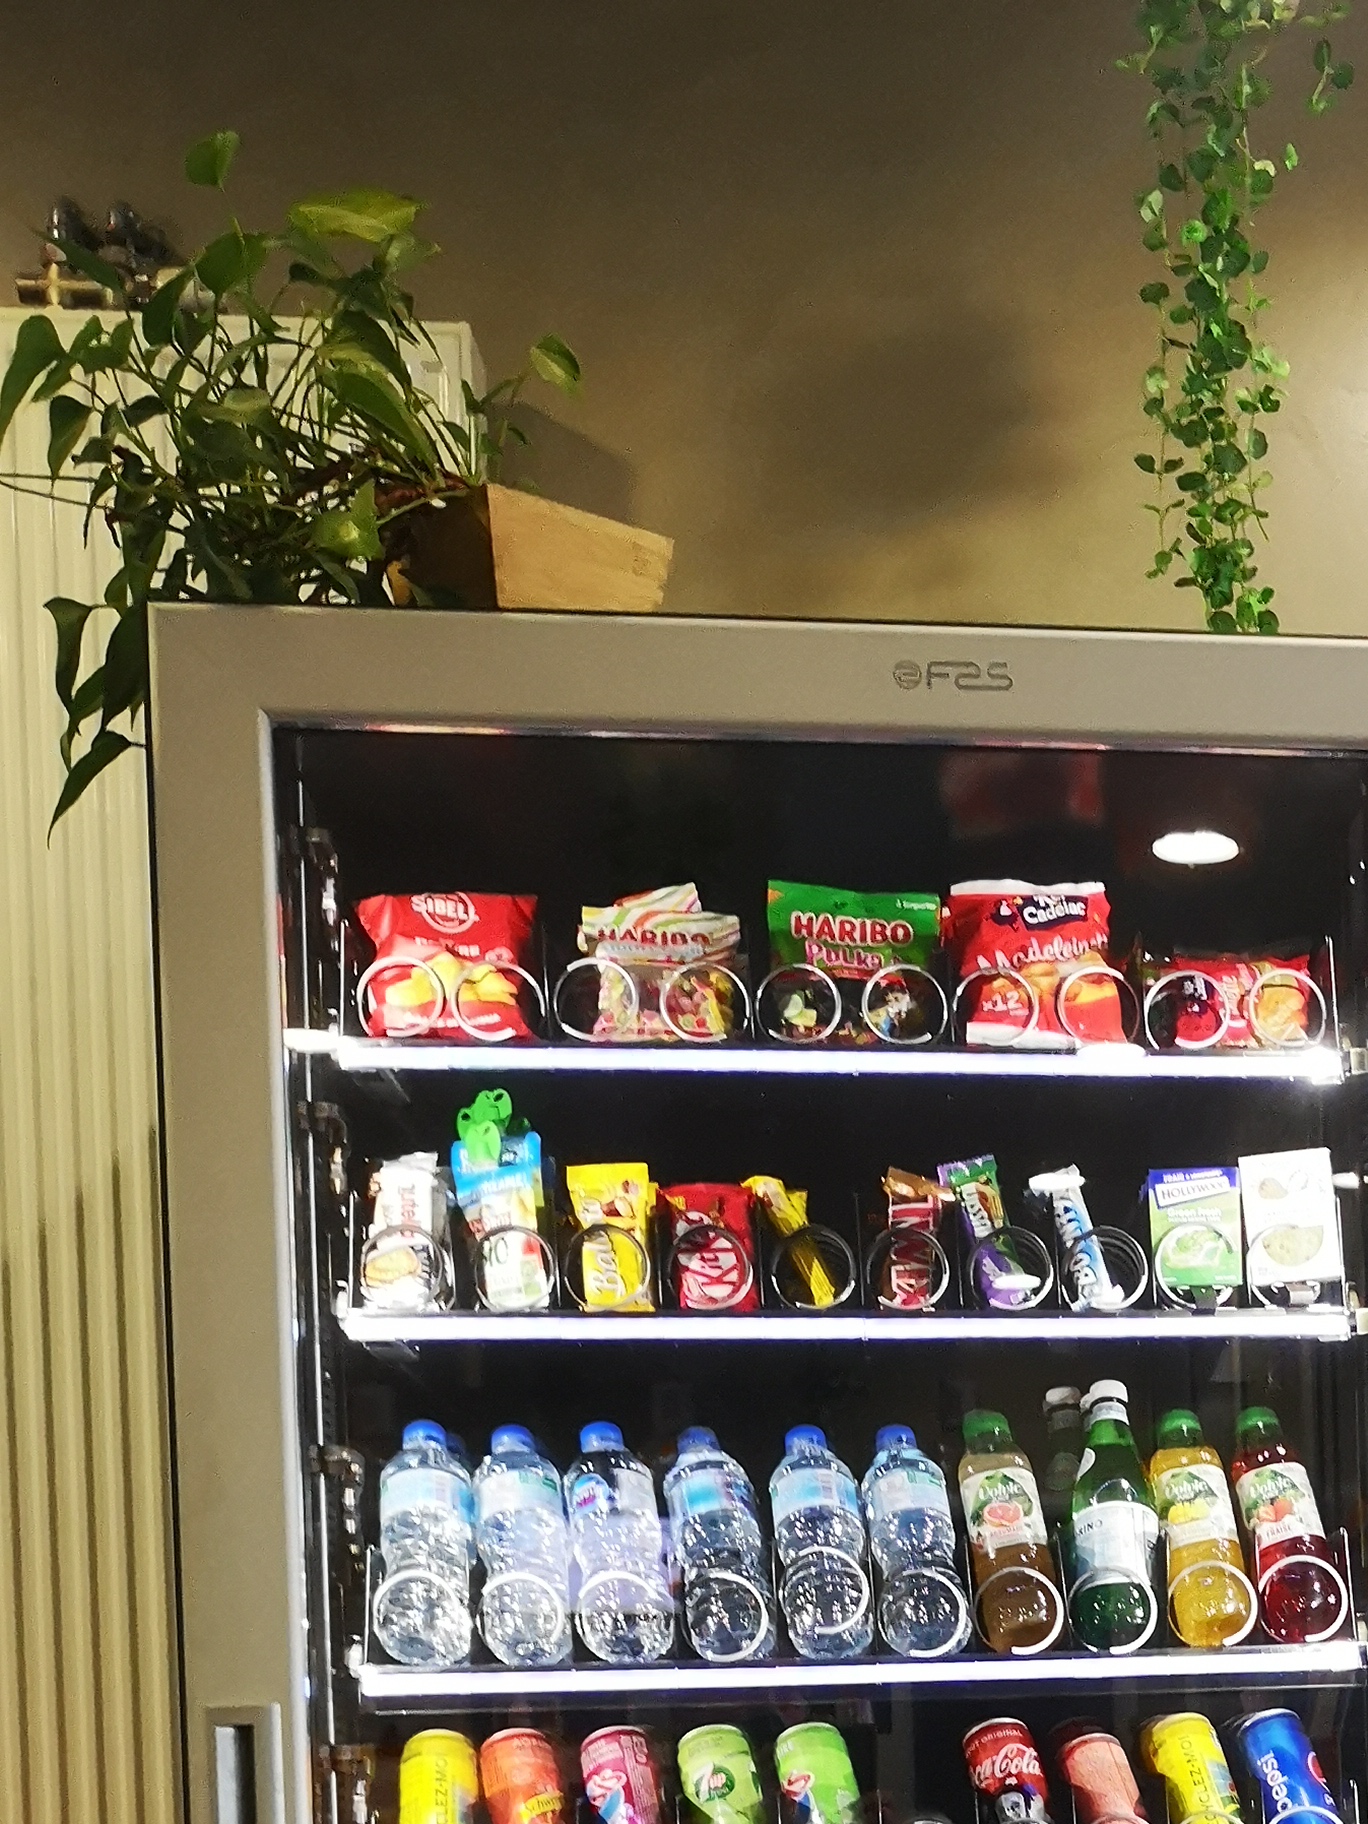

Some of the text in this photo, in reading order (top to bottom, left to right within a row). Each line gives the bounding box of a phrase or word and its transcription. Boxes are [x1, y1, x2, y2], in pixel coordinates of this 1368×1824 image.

[410, 893, 473, 922] SIBEL
[790, 911, 914, 948] HARIBO
[1161, 1181, 1226, 1199] HOLLYW
